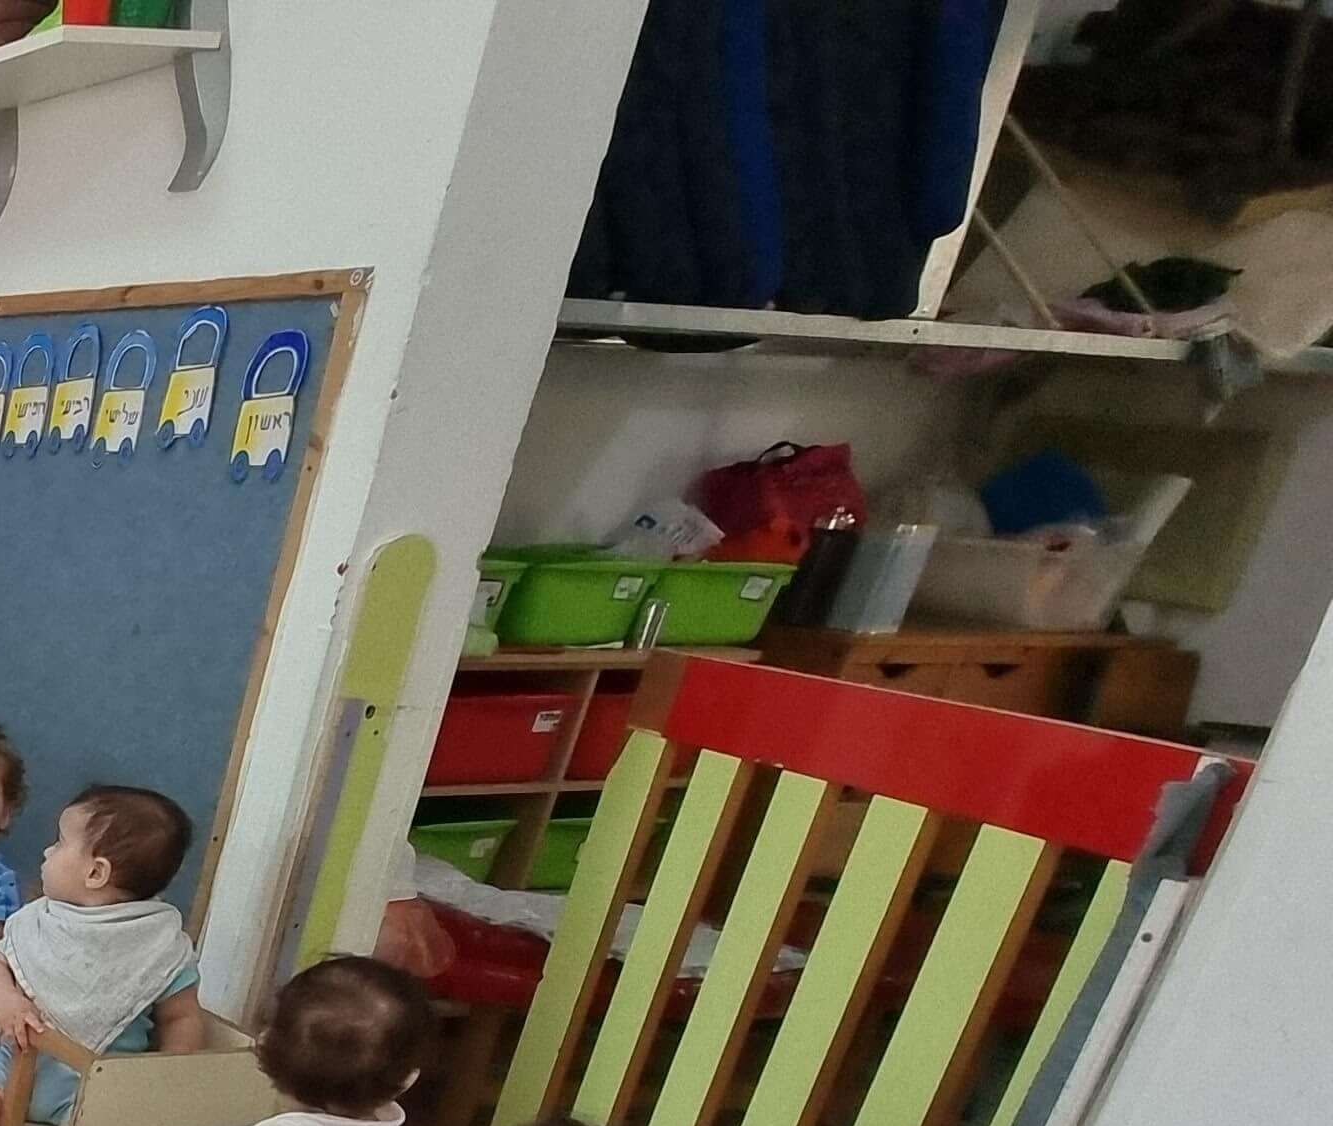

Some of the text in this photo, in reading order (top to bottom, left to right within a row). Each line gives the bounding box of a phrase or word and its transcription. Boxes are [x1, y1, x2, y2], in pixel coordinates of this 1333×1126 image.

[105, 401, 140, 426] שלישי
[176, 385, 209, 417] שני
[245, 411, 293, 445] ראשון
